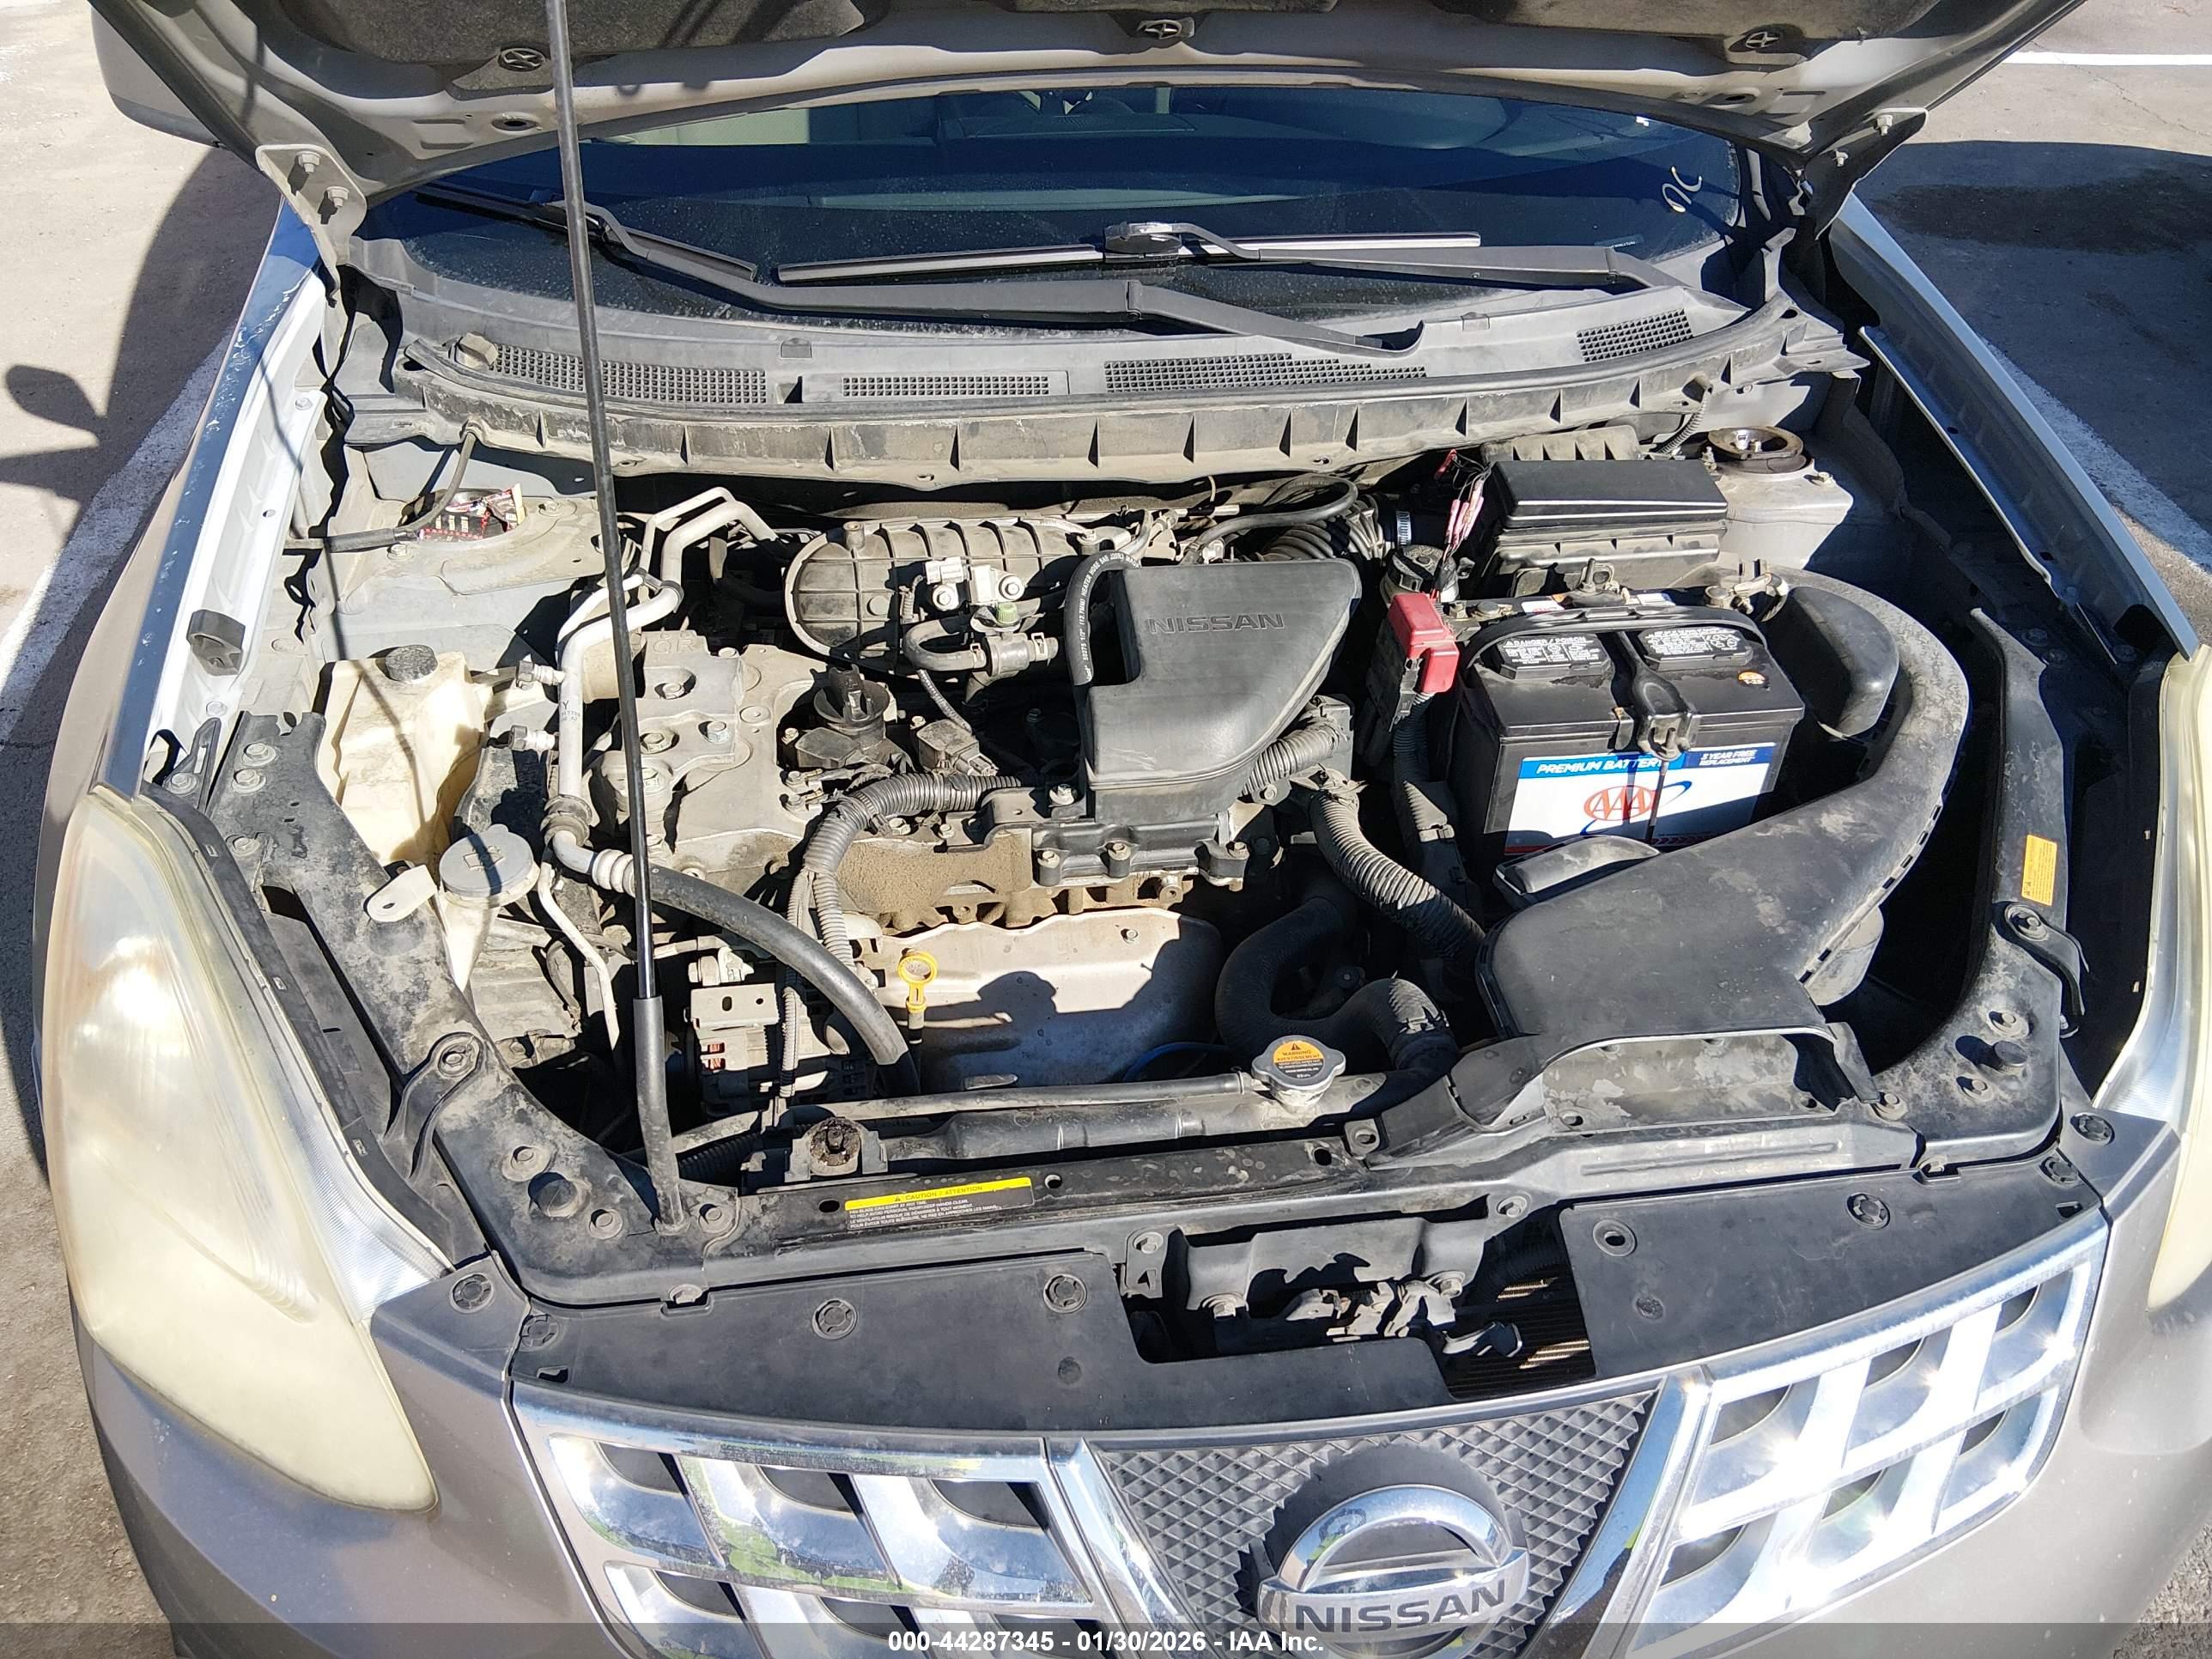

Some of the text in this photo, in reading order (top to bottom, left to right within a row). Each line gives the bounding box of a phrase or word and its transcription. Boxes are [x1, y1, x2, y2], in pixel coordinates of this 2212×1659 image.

[1080, 574, 1092, 597] HEATER
[1088, 561, 1101, 576] HOSE
[1148, 612, 1285, 634] NISSAN
[1536, 760, 1602, 775] PREMIUM
[1699, 757, 1755, 766] REPLACEMENT
[1592, 787, 1648, 818] AAA
[906, 1192, 937, 1200] CAUTION
[945, 1186, 983, 1195] ATTENTION
[1295, 1579, 1504, 1632] NISSAN
